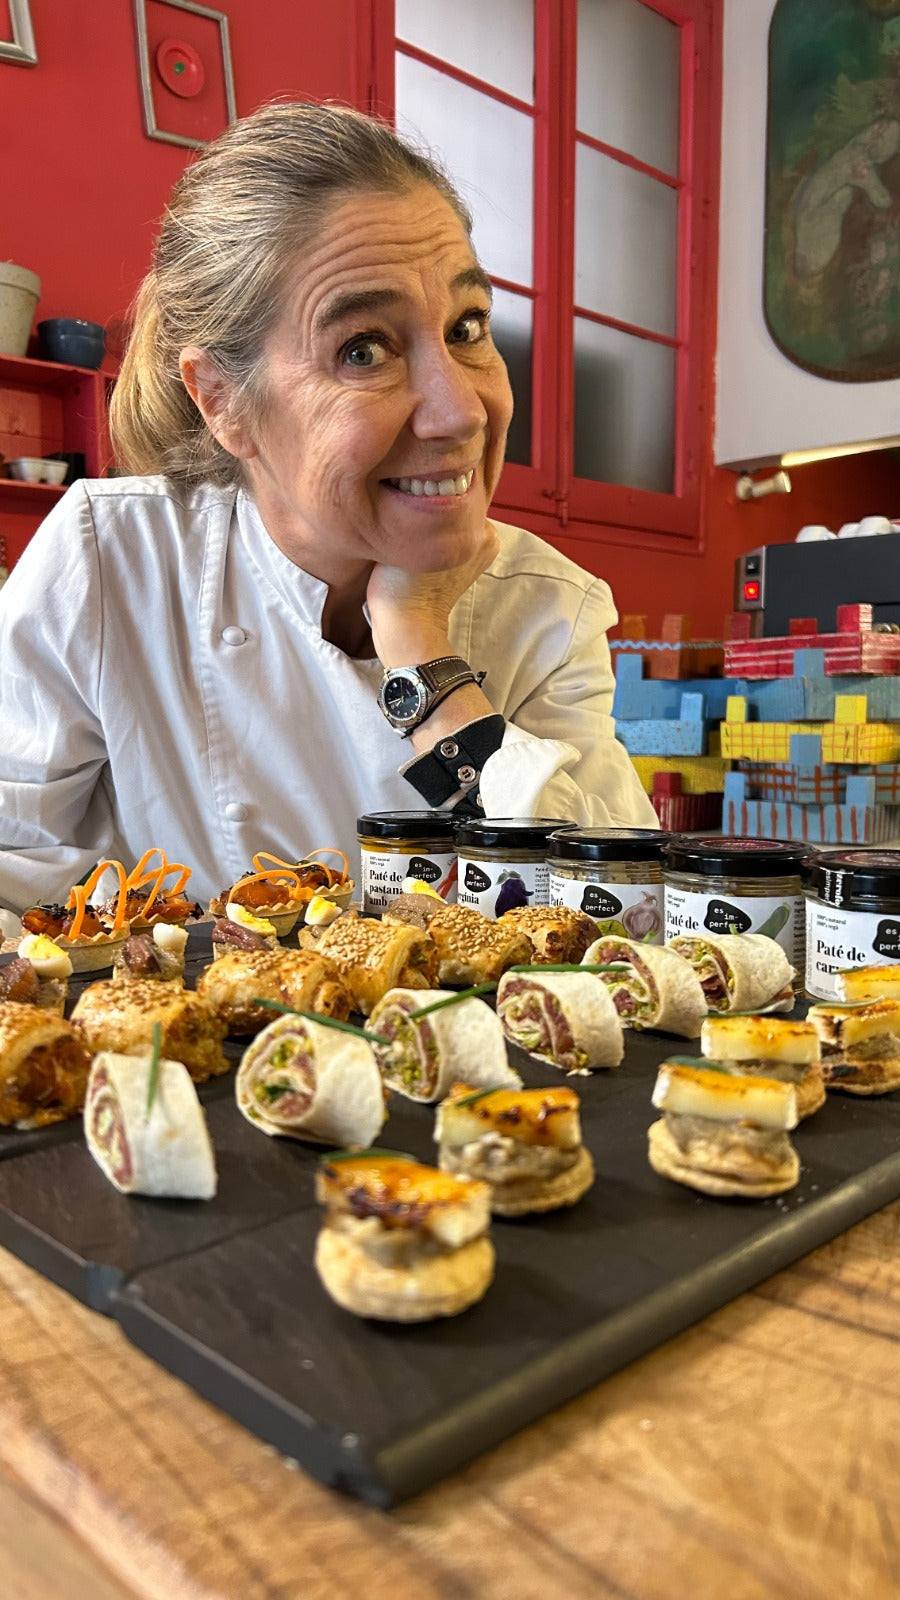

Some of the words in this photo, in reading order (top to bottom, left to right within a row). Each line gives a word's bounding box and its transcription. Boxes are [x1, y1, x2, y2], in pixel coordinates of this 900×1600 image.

[369, 869, 388, 881] Paté
[389, 870, 402, 882] de
[466, 880, 486, 888] perfect
[369, 896, 388, 906] amb
[585, 904, 615, 912] perfect
[666, 910, 684, 927] Paté
[685, 916, 699, 930] de
[709, 921, 743, 929] perfct
[816, 939, 844, 958] Paté
[846, 947, 866, 962] de
